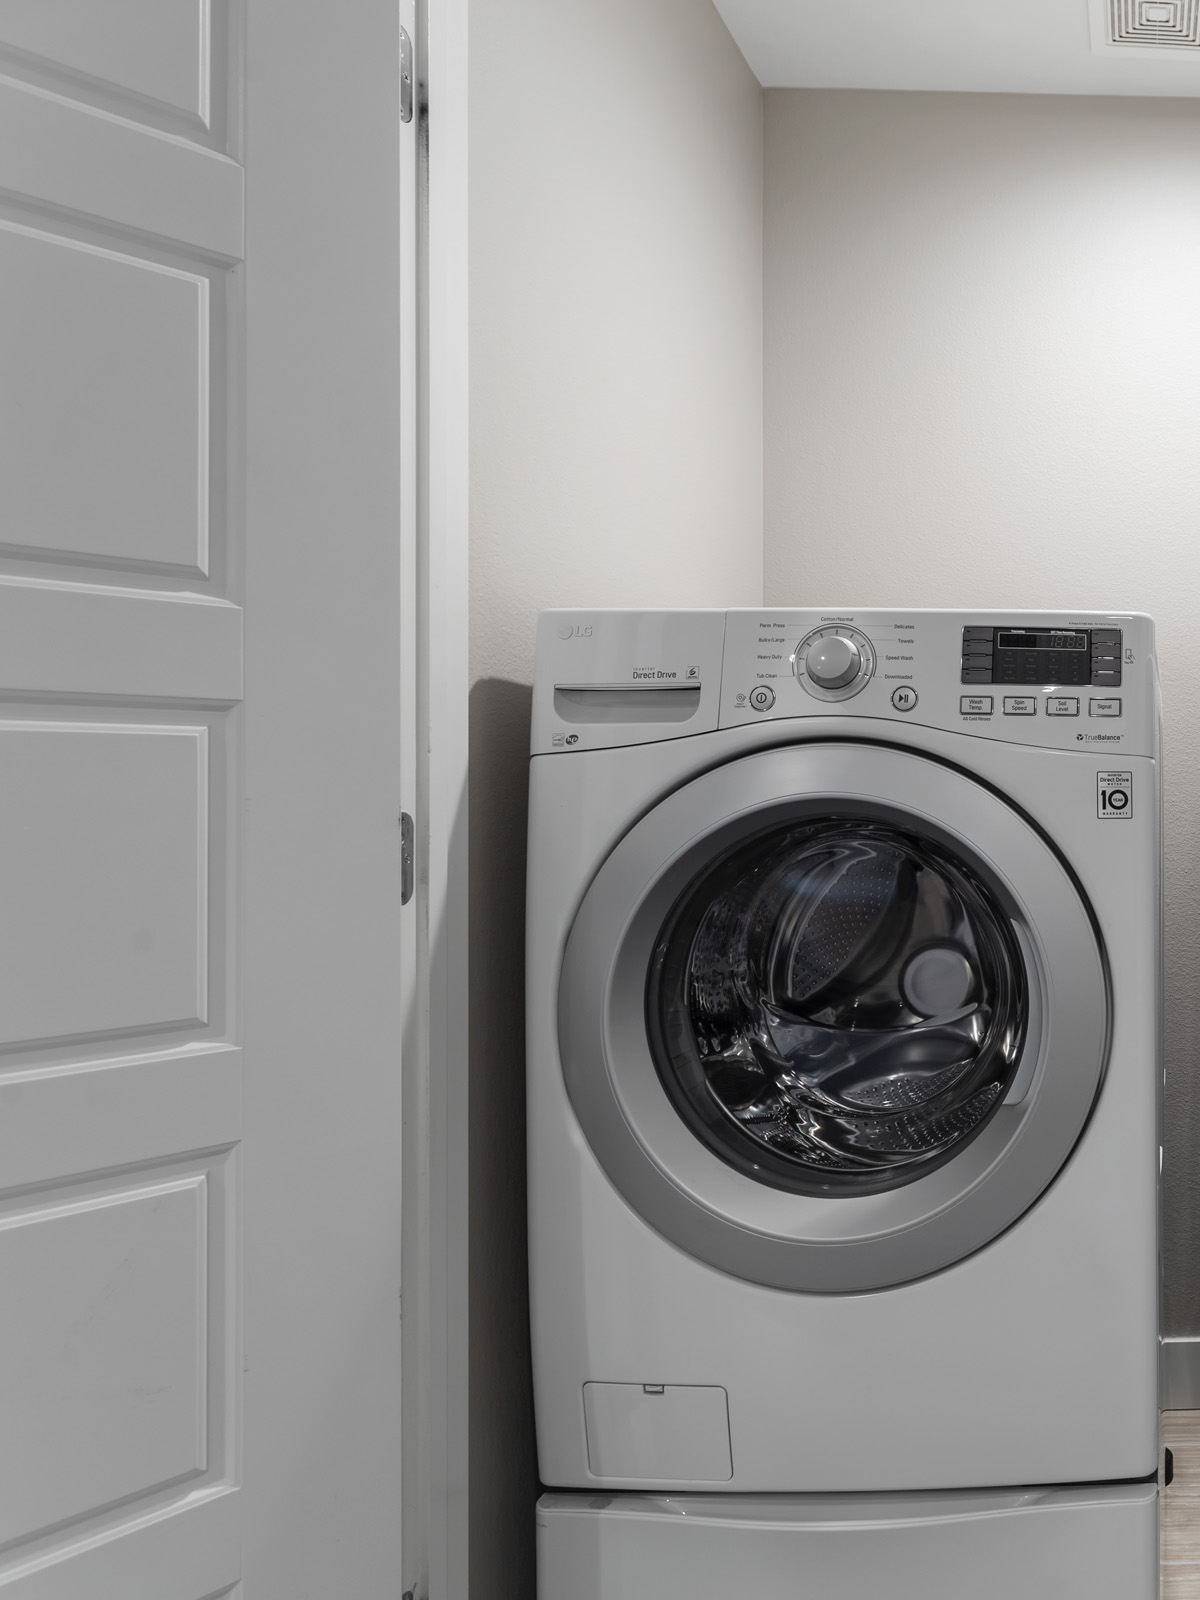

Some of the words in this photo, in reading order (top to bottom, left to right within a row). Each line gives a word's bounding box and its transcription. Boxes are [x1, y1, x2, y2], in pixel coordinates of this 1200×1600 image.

[574, 625, 593, 638] LG
[632, 671, 656, 679] Direct
[657, 670, 677, 679] Drive
[1101, 789, 1129, 810] 10
